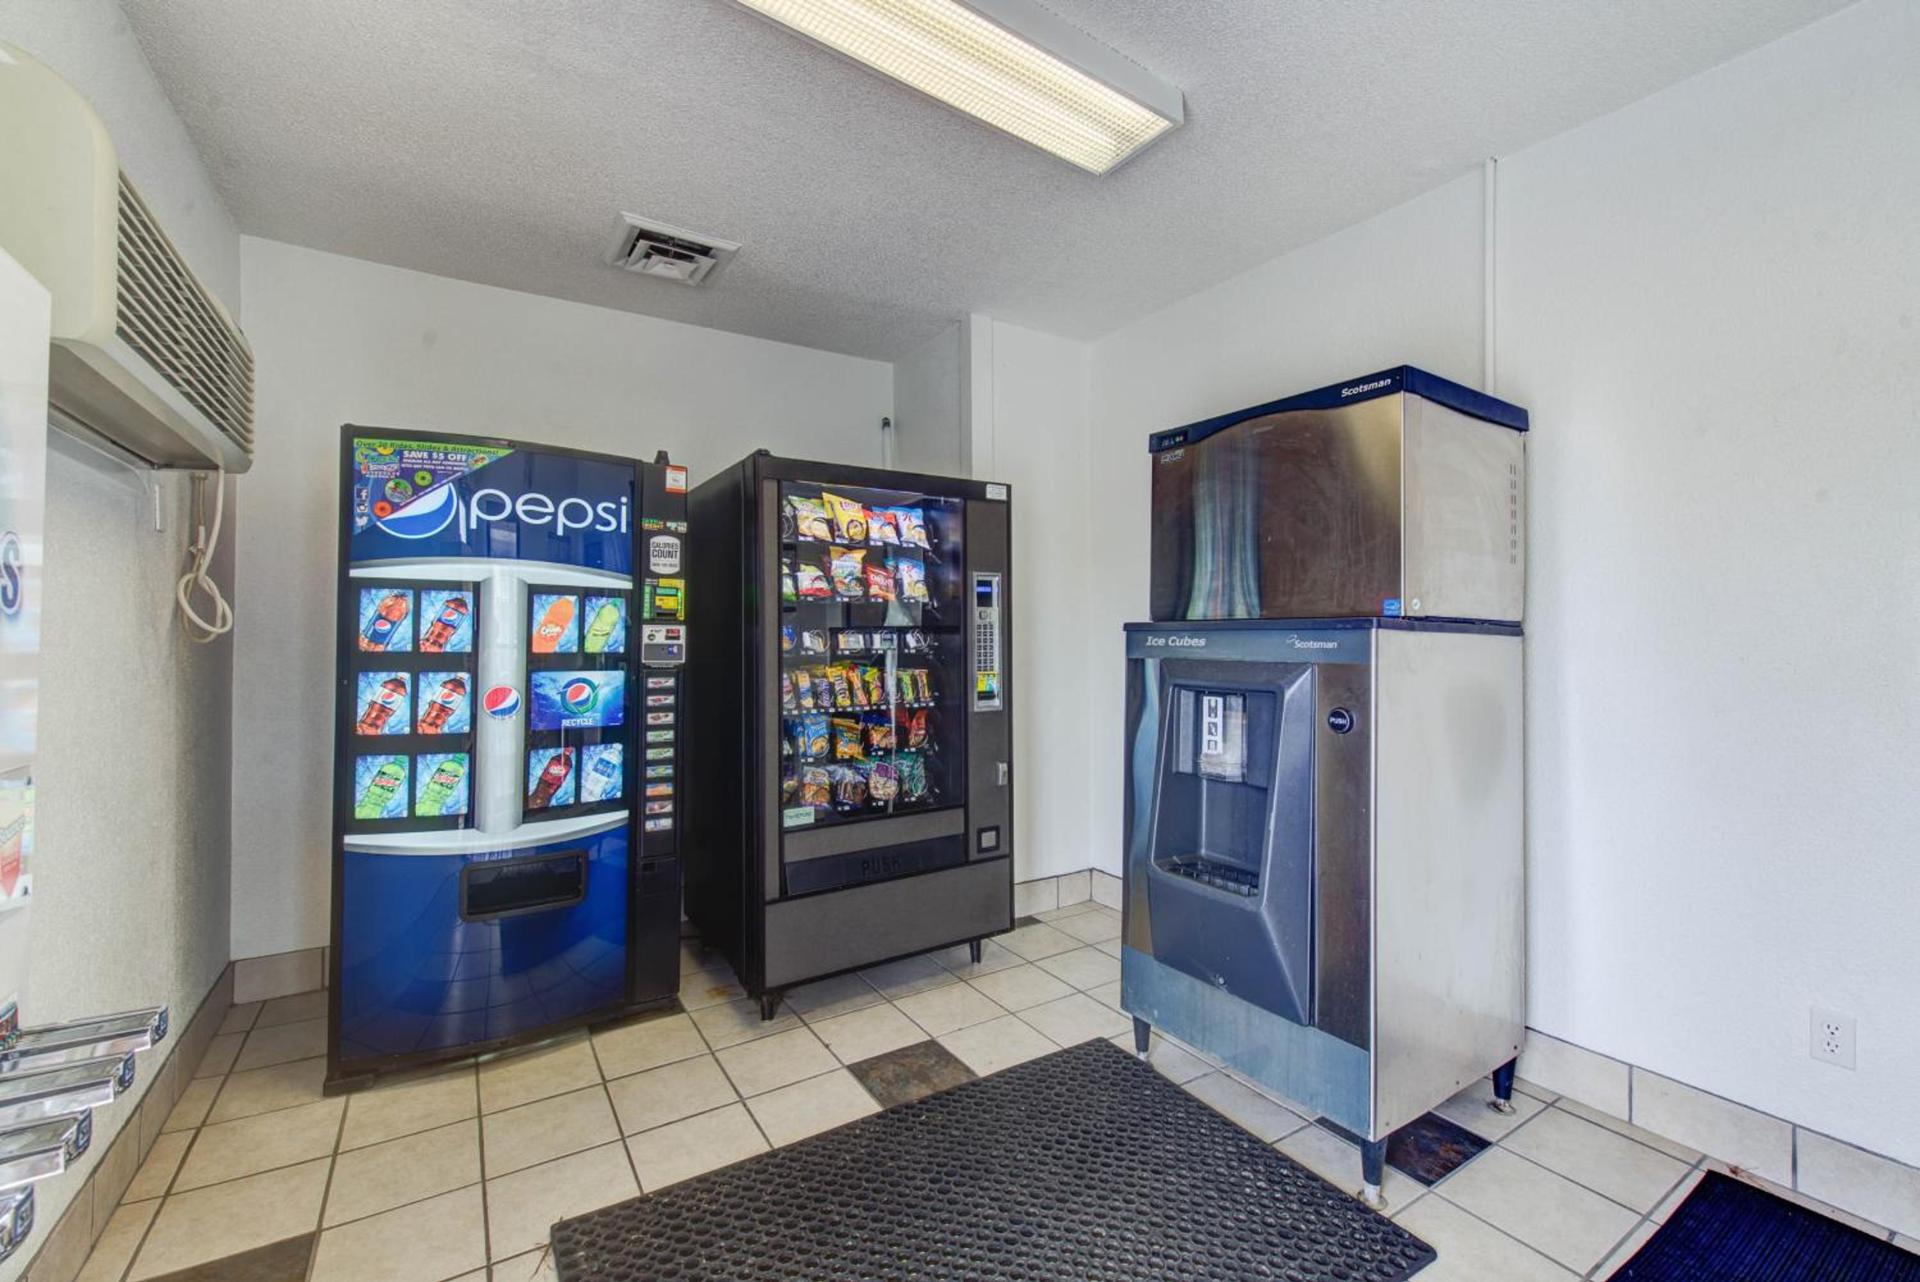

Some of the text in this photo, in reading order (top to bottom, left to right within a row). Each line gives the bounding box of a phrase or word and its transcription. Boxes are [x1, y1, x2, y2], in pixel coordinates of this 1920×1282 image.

[1341, 378, 1392, 398] Scotsman
[403, 450, 467, 461] SAVE $5 OFF
[470, 488, 628, 536] pepsi
[651, 549, 679, 559] COUNT
[1146, 636, 1206, 647] Ice Cubes
[1294, 639, 1338, 649] Scotsman
[561, 718, 593, 727] RECYCLE
[1330, 716, 1347, 725] PUSH
[862, 855, 899, 876] PUSH
